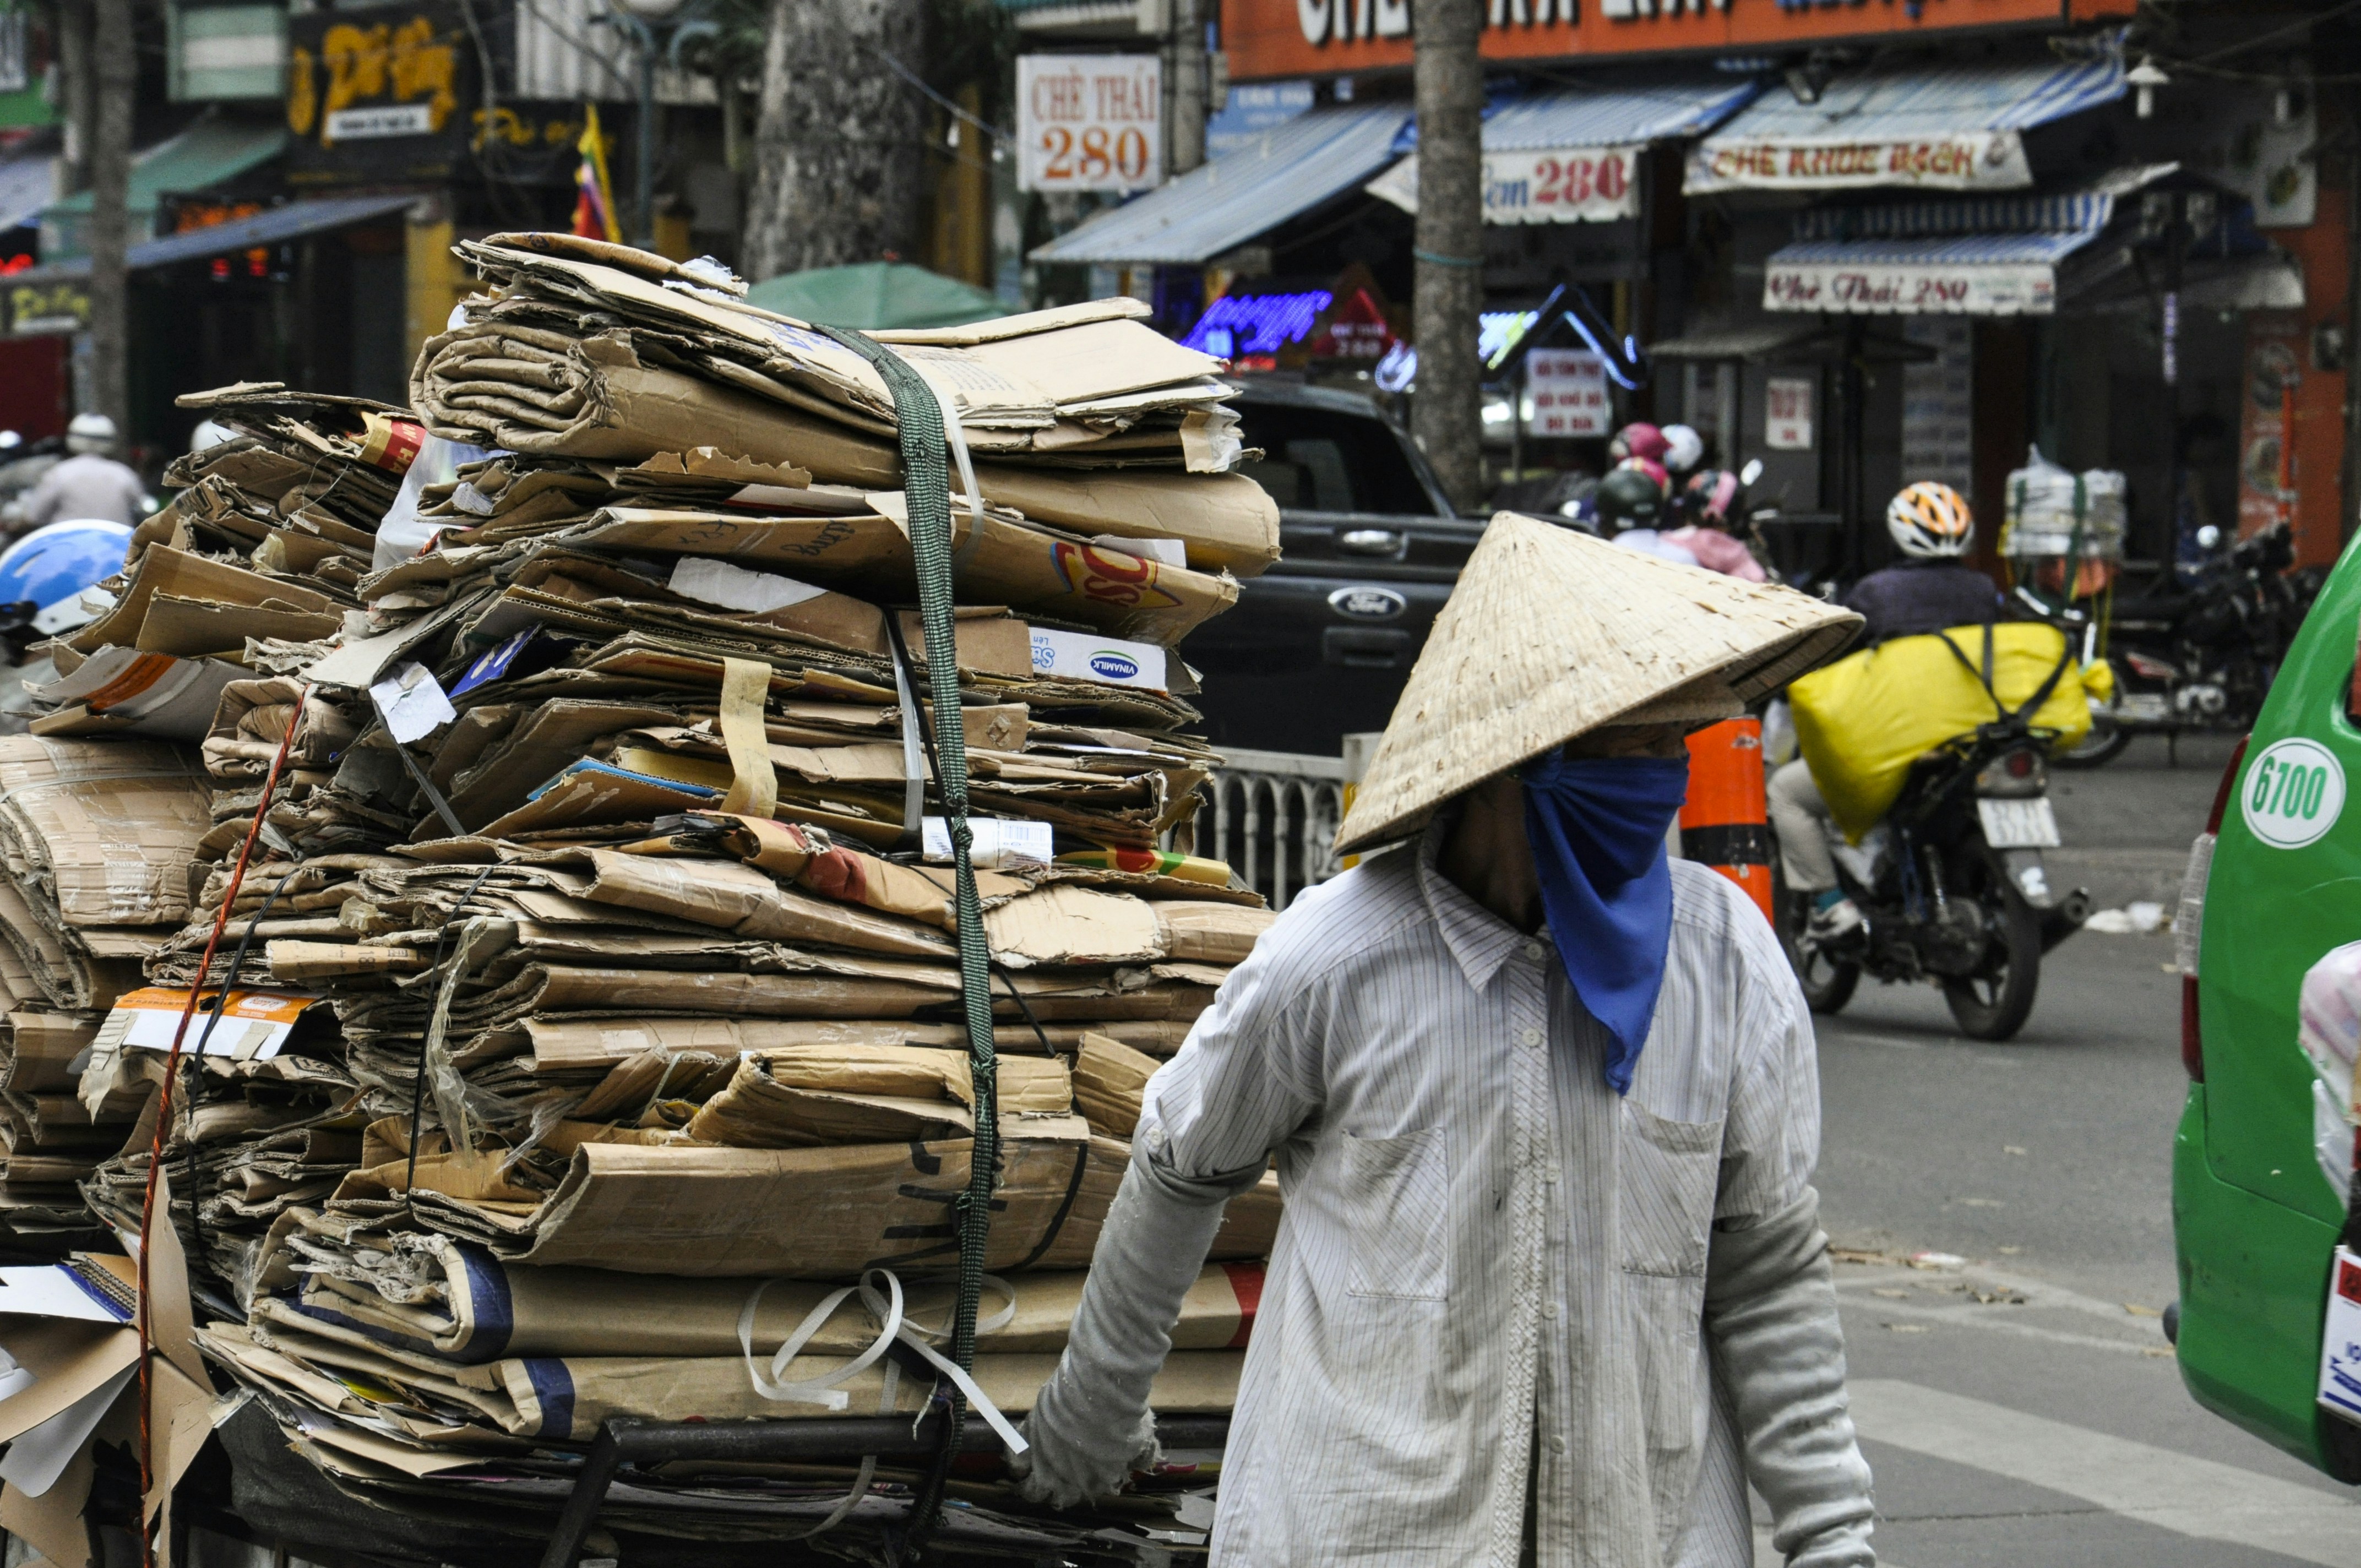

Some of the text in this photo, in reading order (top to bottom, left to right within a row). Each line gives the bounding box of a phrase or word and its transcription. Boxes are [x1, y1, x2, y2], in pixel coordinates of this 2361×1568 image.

[1043, 127, 1148, 182] 280
[1486, 154, 1629, 208] em 280
[1093, 660, 1135, 675] VINAMILK
[2252, 756, 2326, 819] 6700
